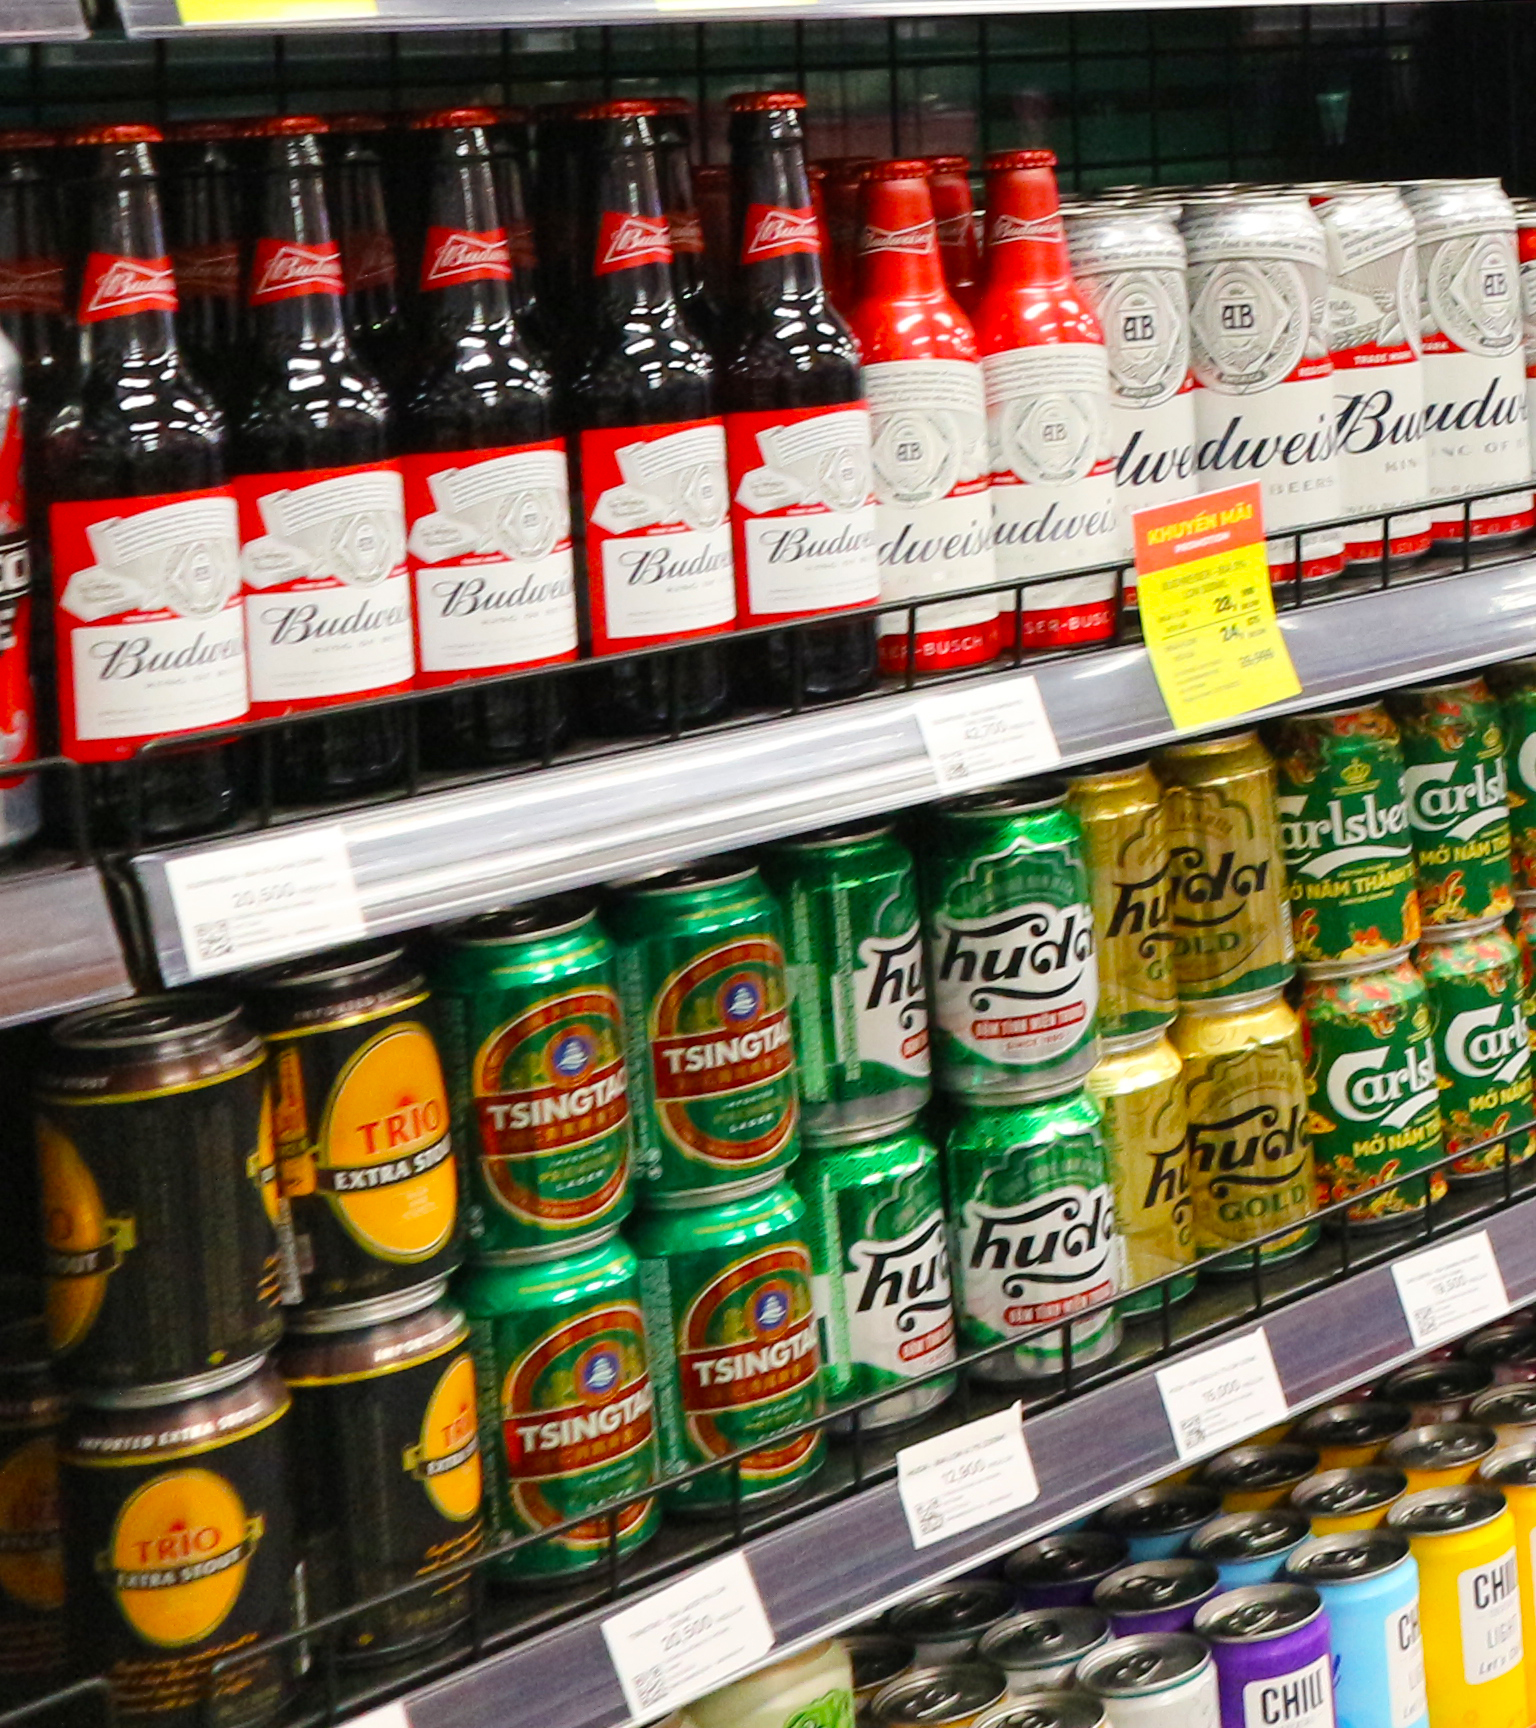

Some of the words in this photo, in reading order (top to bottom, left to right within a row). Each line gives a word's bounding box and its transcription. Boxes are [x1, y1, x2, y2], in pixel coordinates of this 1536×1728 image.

[356, 1101, 444, 1156] TRIO
[333, 1159, 411, 1192] EXTRA
[132, 1526, 223, 1565] TRIO
[1259, 1674, 1326, 1726] CHILL
